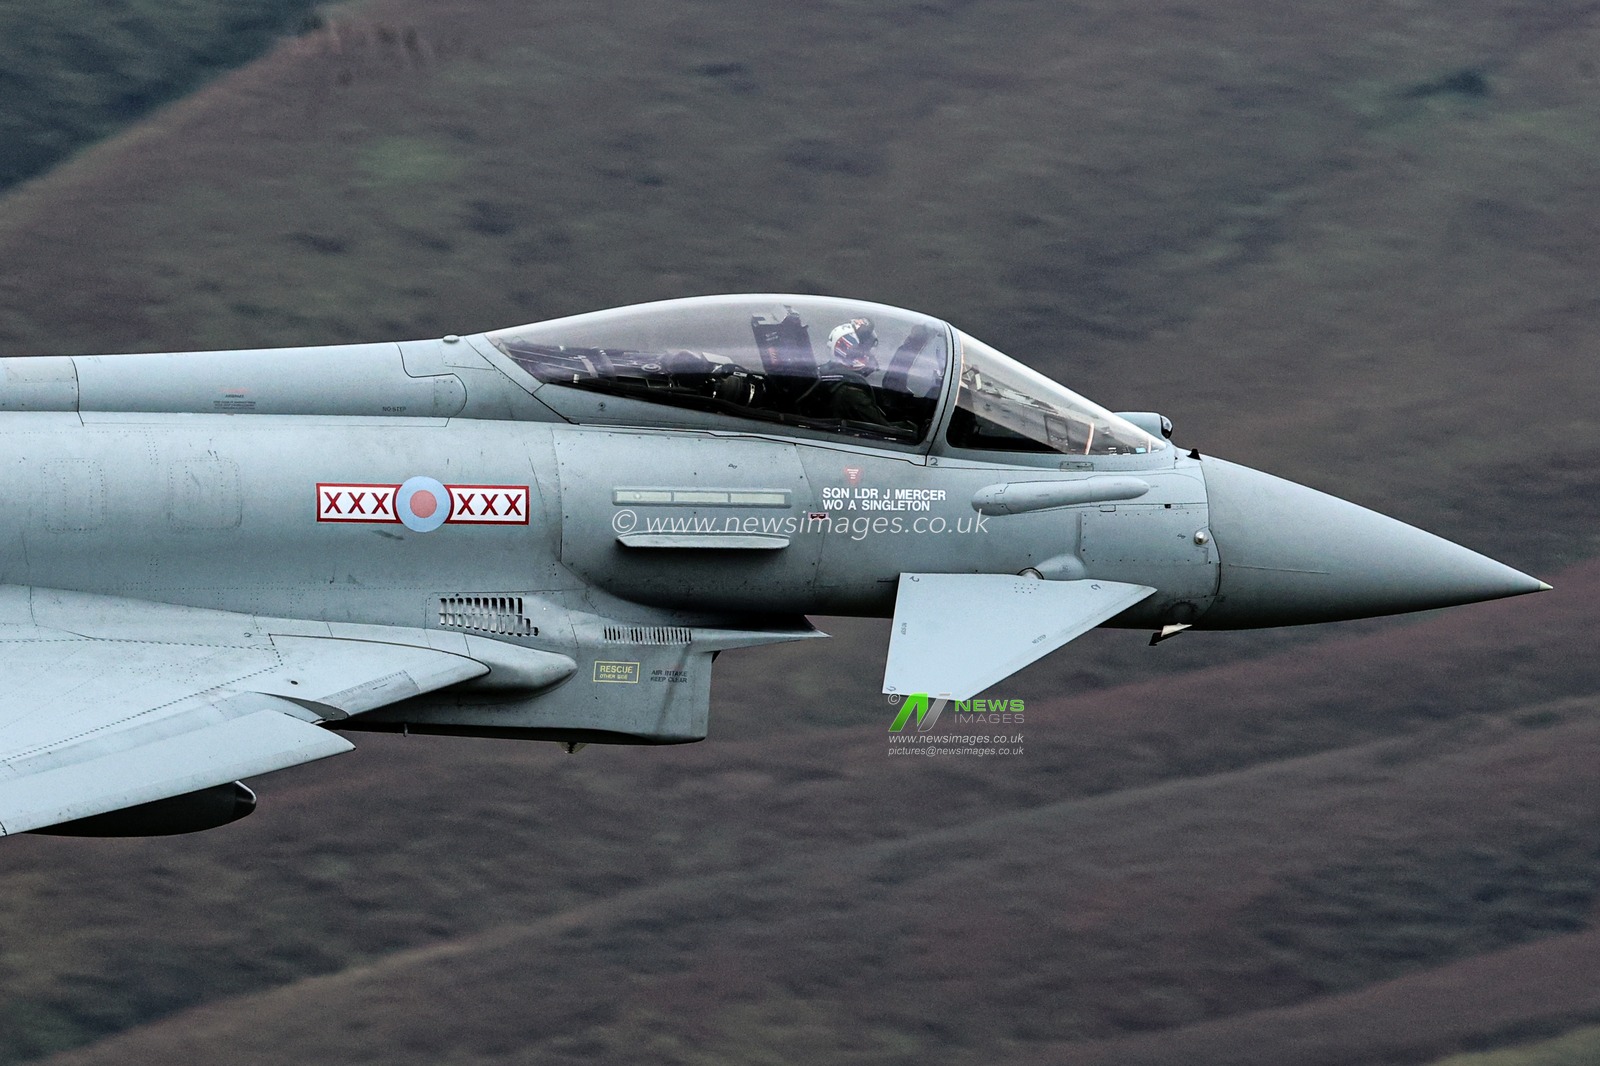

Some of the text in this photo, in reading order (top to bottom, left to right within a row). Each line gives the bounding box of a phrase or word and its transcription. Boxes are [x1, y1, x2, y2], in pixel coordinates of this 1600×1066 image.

[822, 487, 946, 501] SQN LDR J MERCER
[822, 500, 931, 512] WO A SINGLETON
[599, 665, 633, 674] RESCUE
